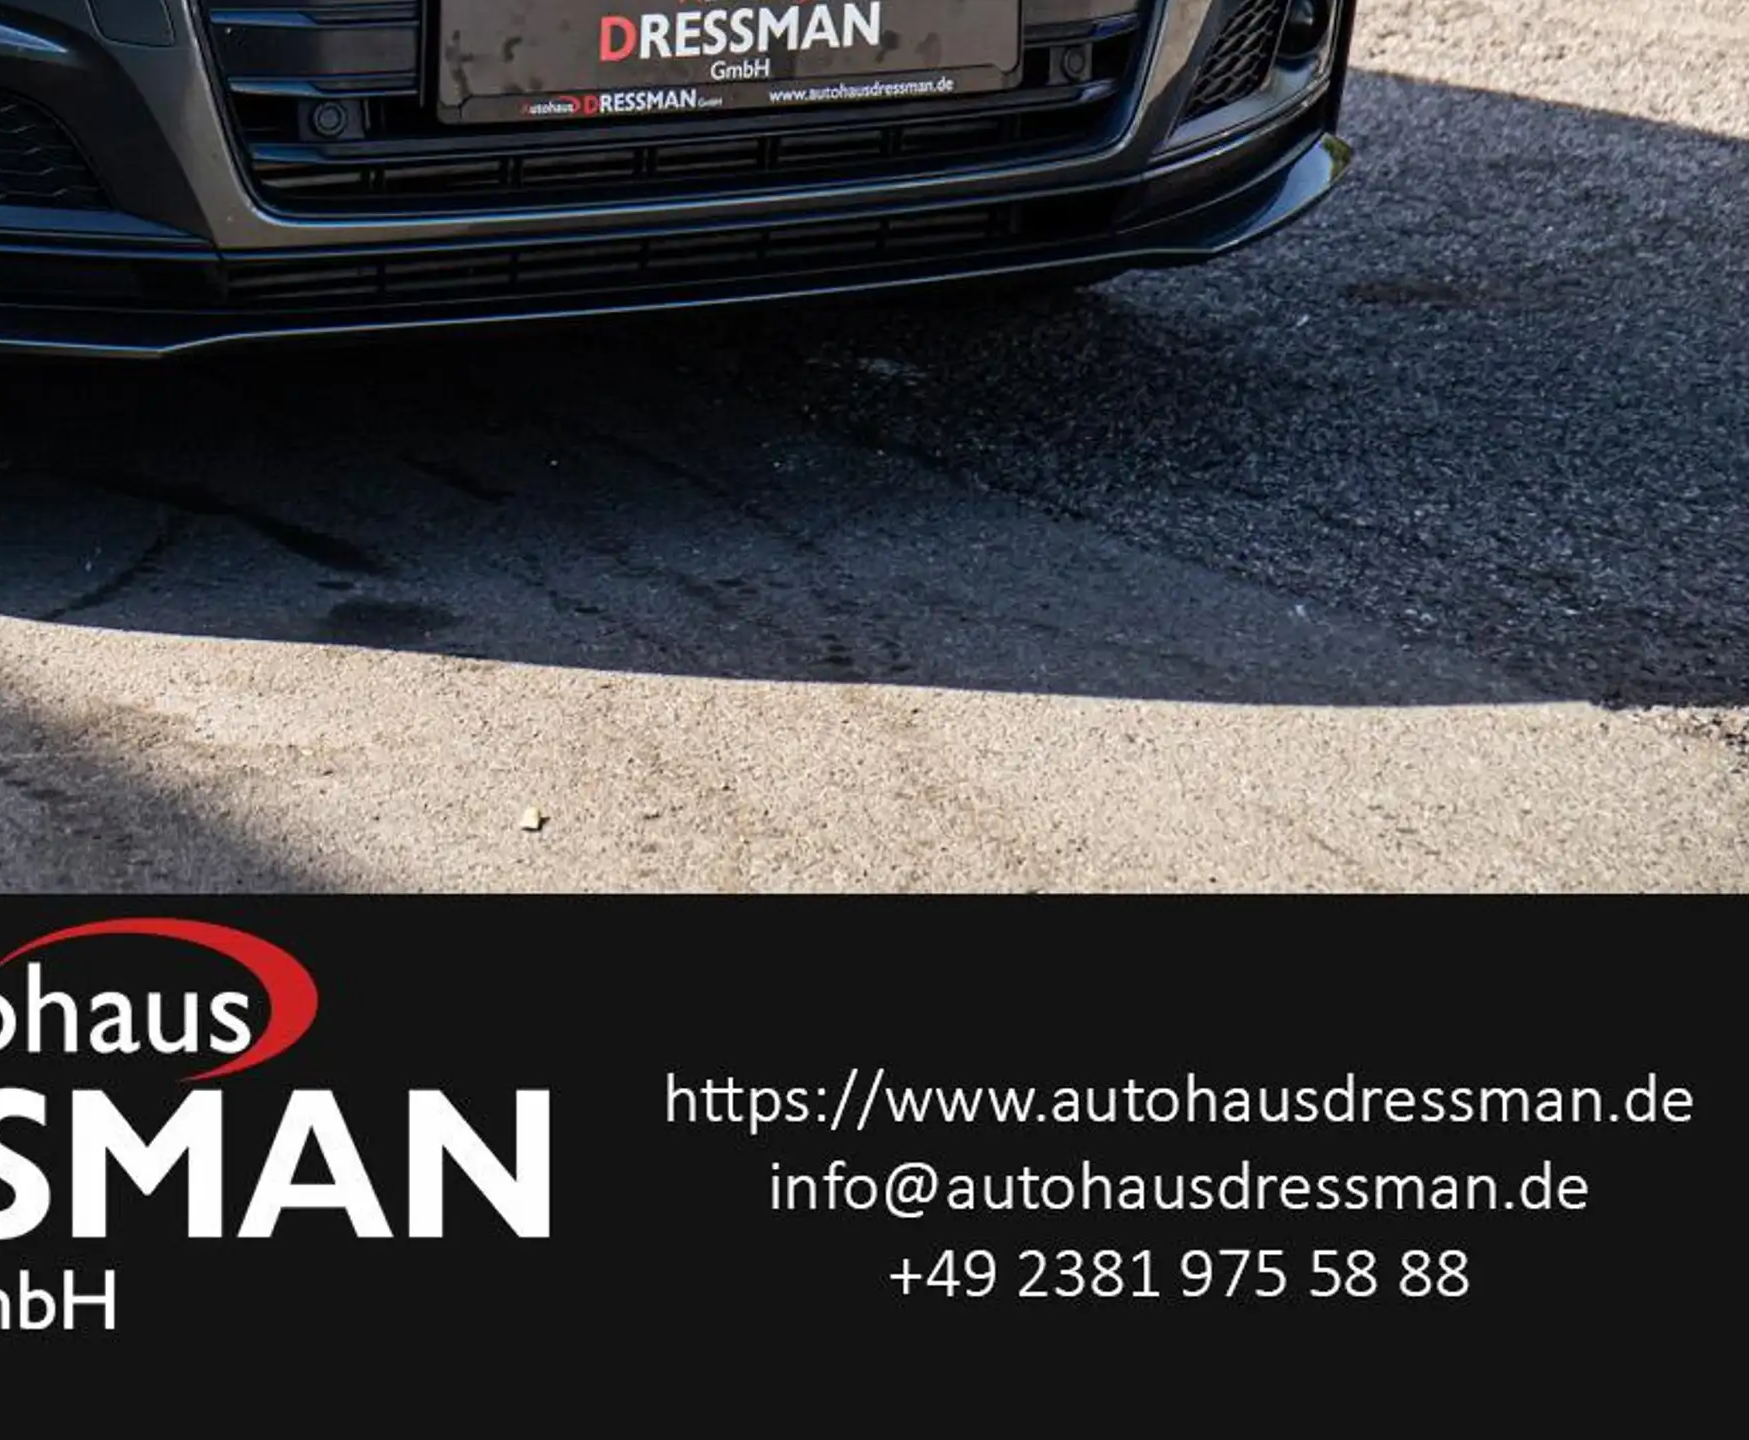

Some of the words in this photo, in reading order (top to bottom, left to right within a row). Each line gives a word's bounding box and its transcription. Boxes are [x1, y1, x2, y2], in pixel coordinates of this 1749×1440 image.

[599, 1, 881, 61] DRESSMAN
[711, 58, 771, 80] GmbH
[583, 88, 697, 114] DRESSMAN
[769, 75, 955, 102] www.autohausdressman.de
